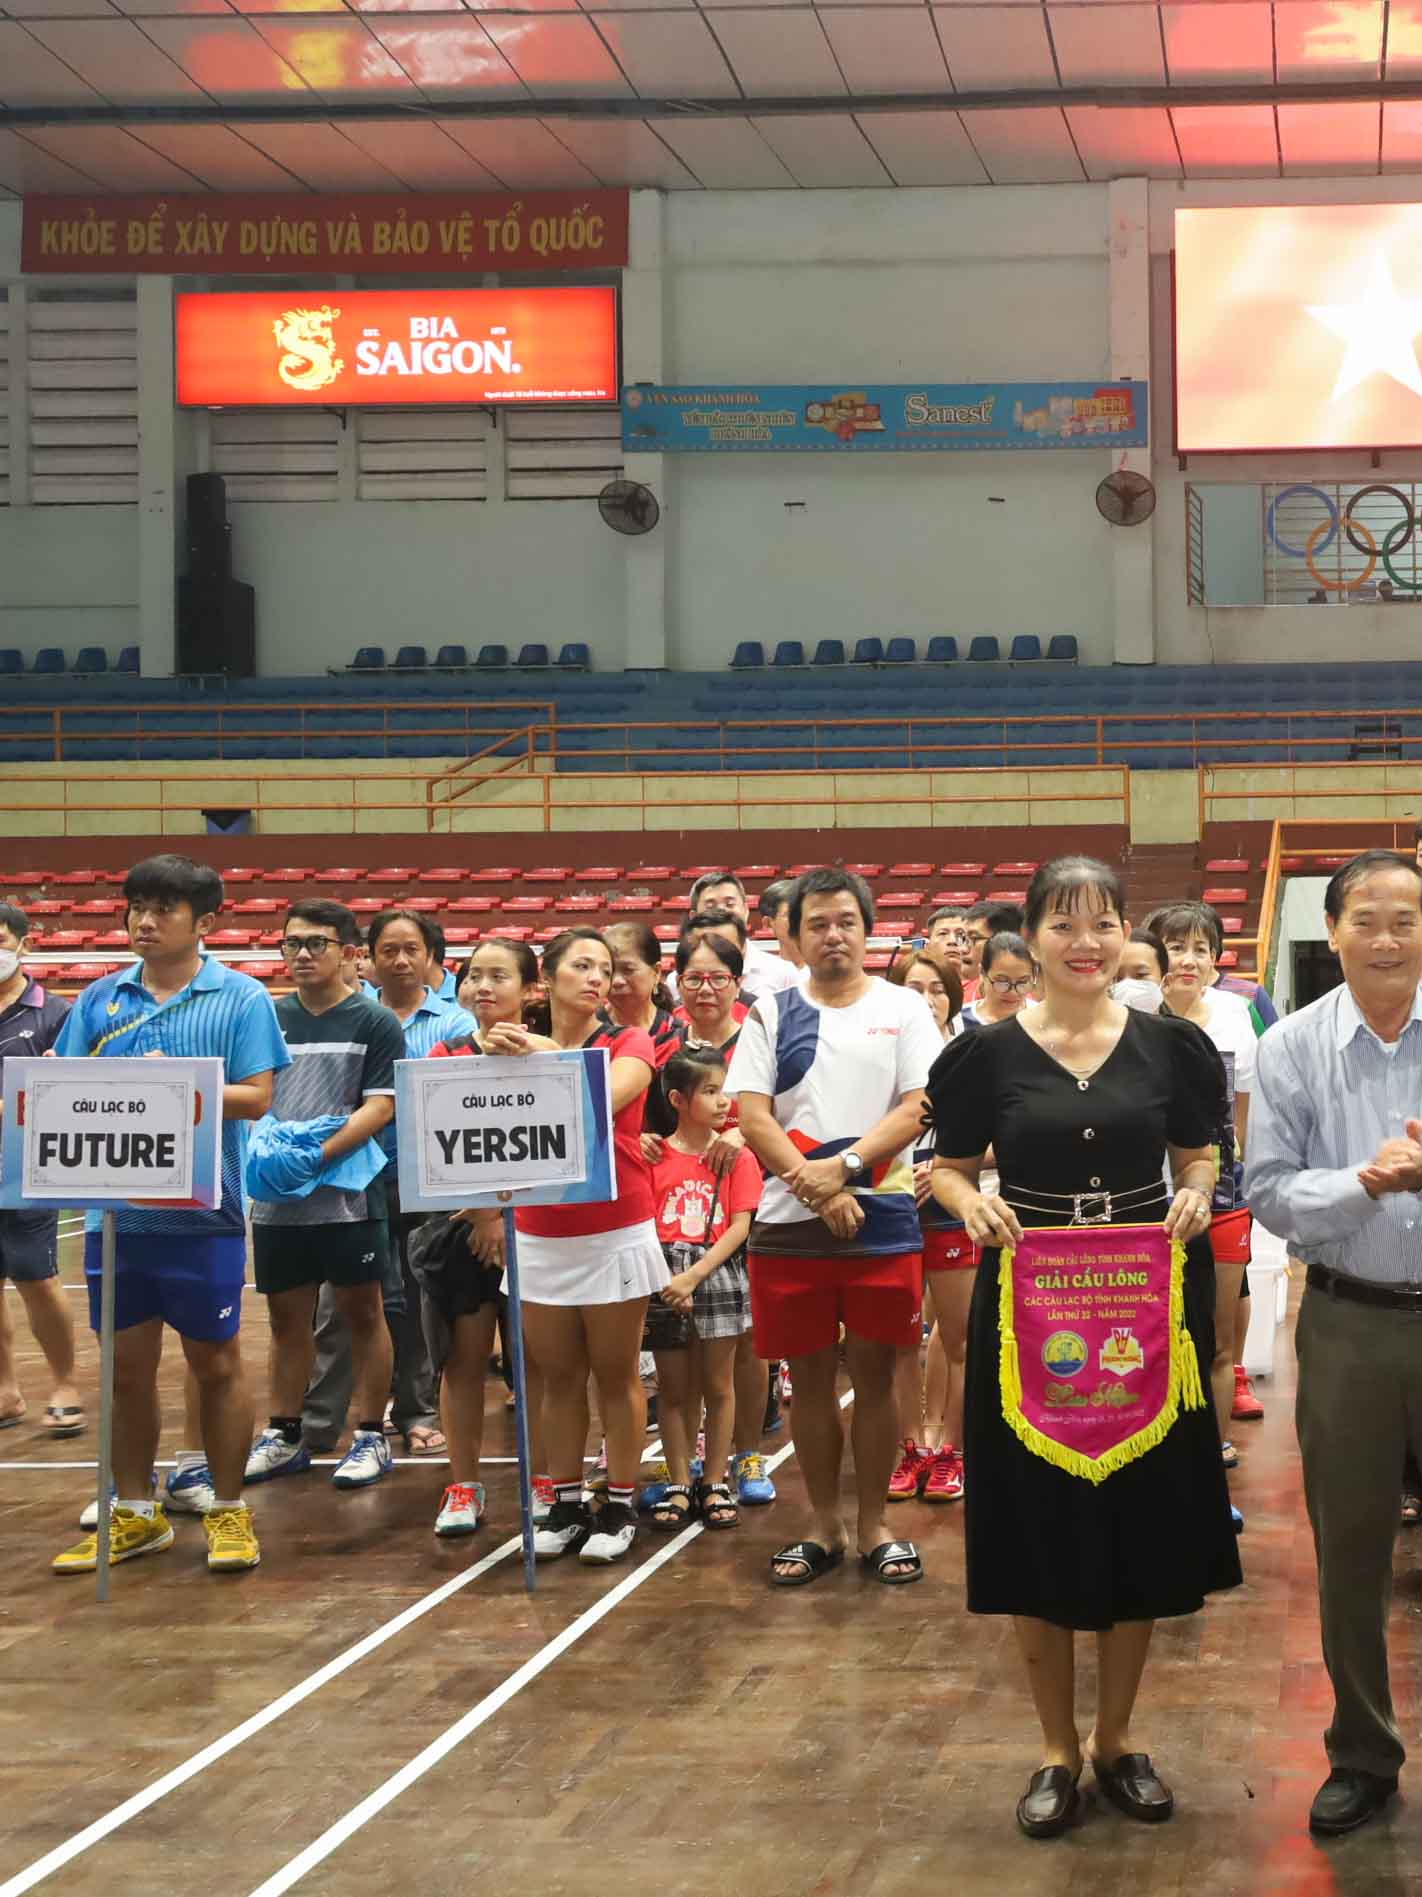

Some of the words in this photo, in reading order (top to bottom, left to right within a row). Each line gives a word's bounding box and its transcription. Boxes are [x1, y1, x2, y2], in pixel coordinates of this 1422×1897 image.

[39, 206, 117, 254] KHỎE
[126, 203, 168, 254] ĐỂ
[174, 213, 229, 255] XÂY
[239, 215, 320, 262] DỰNG
[327, 211, 363, 255] VÀ
[373, 207, 430, 255] BẢO
[439, 210, 473, 262] VỆ
[484, 200, 523, 253] TỔ
[528, 202, 605, 256] QUỐC
[409, 316, 459, 339] BIA
[906, 392, 991, 425] Sanest
[101, 1100, 124, 1116] LẠC
[490, 1094, 514, 1110] LẠC
[39, 1132, 175, 1167] FUTURE
[434, 1124, 567, 1165] YERSIN
[1108, 1268, 1148, 1287] LÔNG
